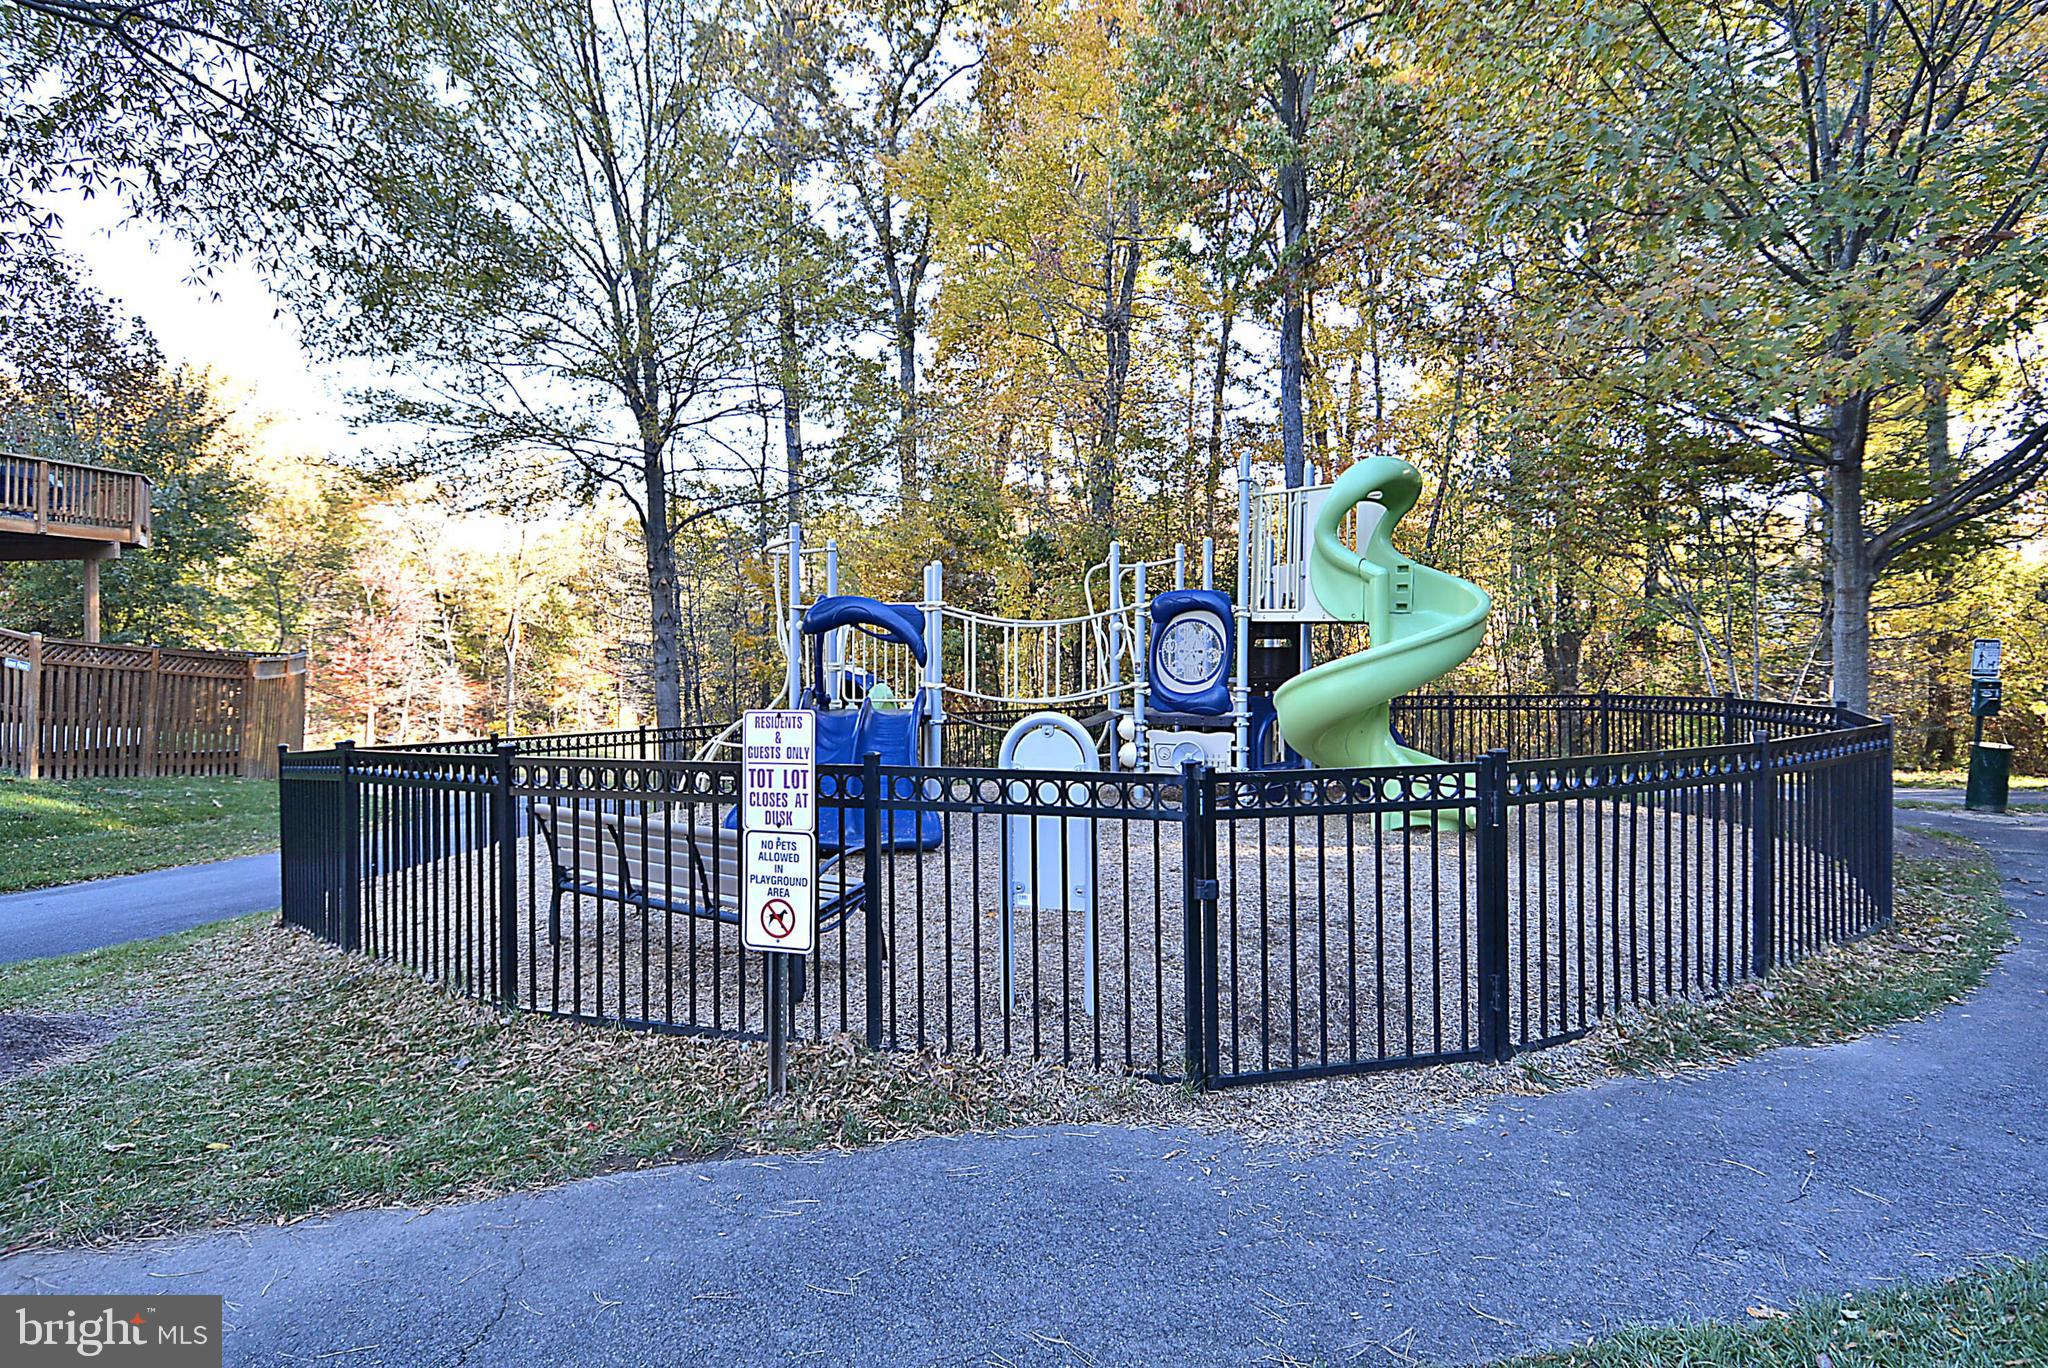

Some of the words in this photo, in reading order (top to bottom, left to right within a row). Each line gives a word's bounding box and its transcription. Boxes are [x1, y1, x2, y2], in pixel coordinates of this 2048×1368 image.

[755, 716, 803, 729] RESIDENTS
[775, 731, 781, 744] &
[748, 746, 781, 759] GUESTS
[786, 747, 810, 760] ONLY
[748, 768, 774, 788] TOT
[783, 769, 809, 790] LOT
[749, 791, 788, 808] CLOSES
[794, 793, 809, 808] AT
[765, 810, 793, 826] DUSK
[761, 840, 774, 850] NO
[775, 840, 797, 851] PETS
[758, 851, 800, 863] ALLOWED
[774, 864, 784, 874] IN
[749, 874, 808, 888] PLAYGROUND
[767, 887, 790, 898] AREA
